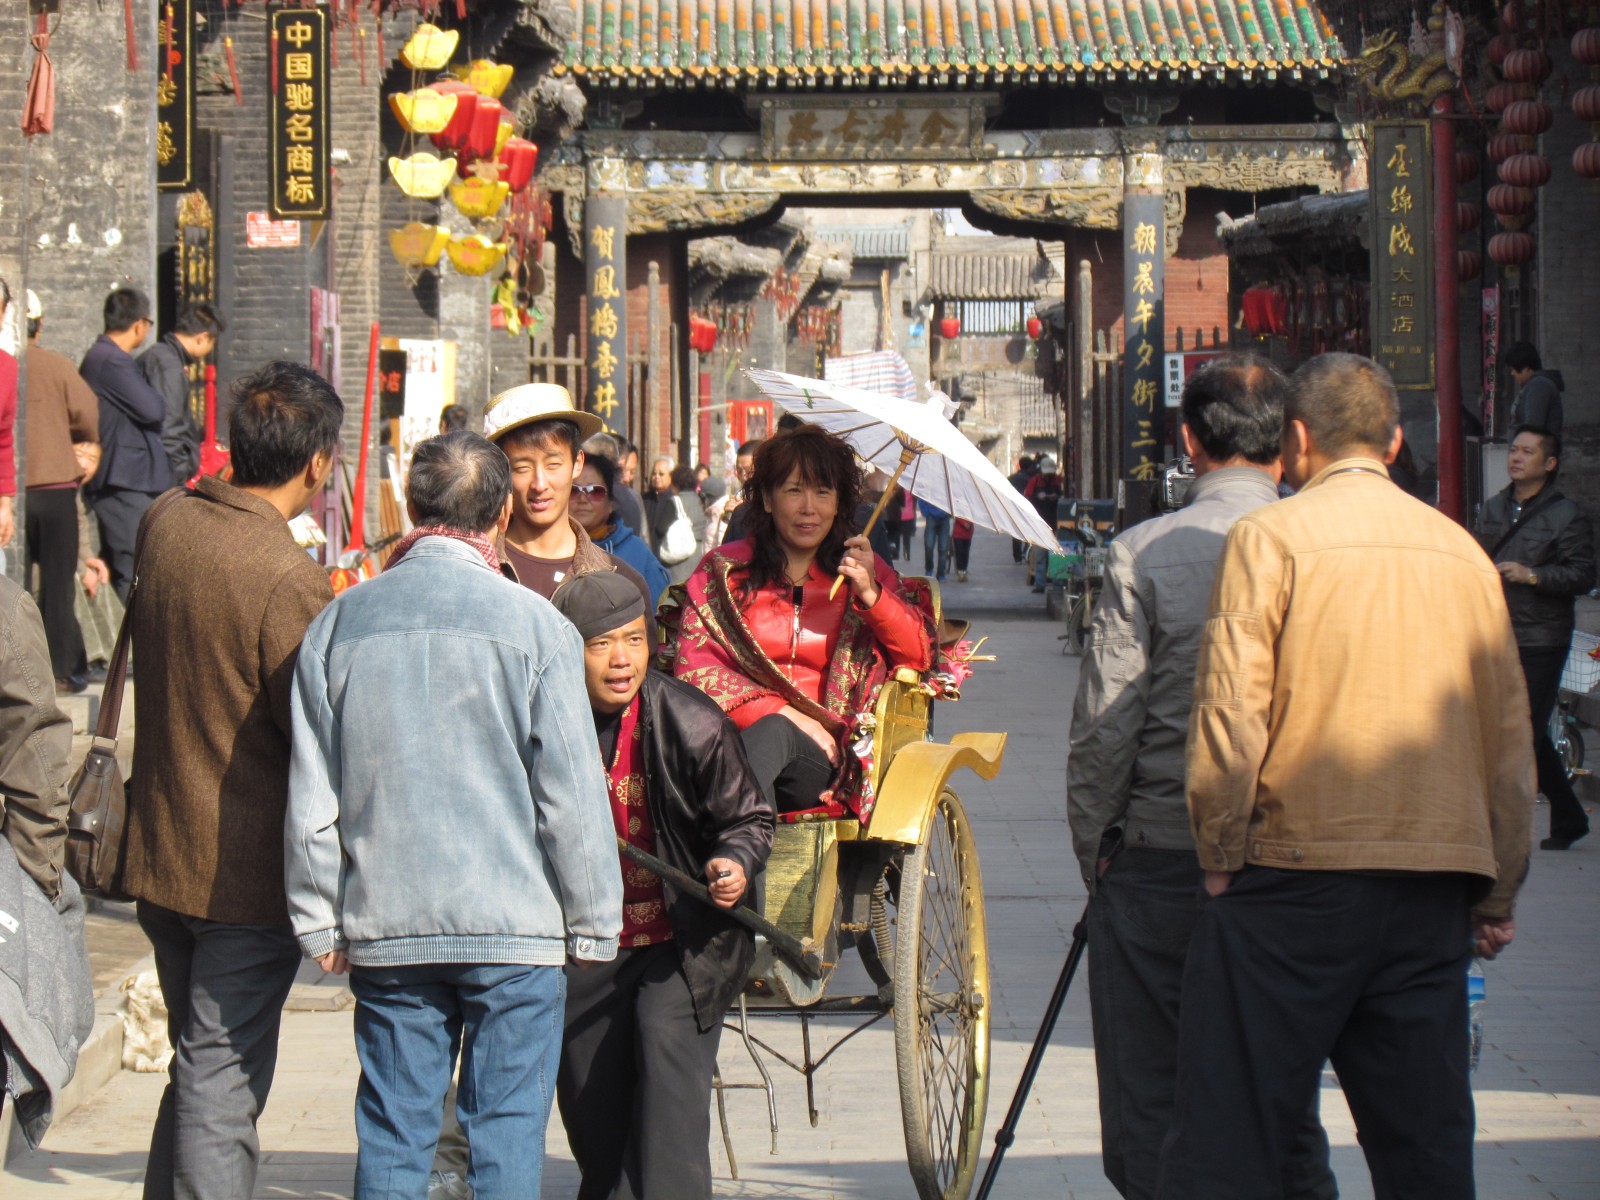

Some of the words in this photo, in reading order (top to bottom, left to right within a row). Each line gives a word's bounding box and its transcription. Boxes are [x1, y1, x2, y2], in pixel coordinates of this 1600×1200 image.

[285, 21, 314, 203] 中国驰名商标
[591, 224, 620, 433] 賀鳳橋臺井
